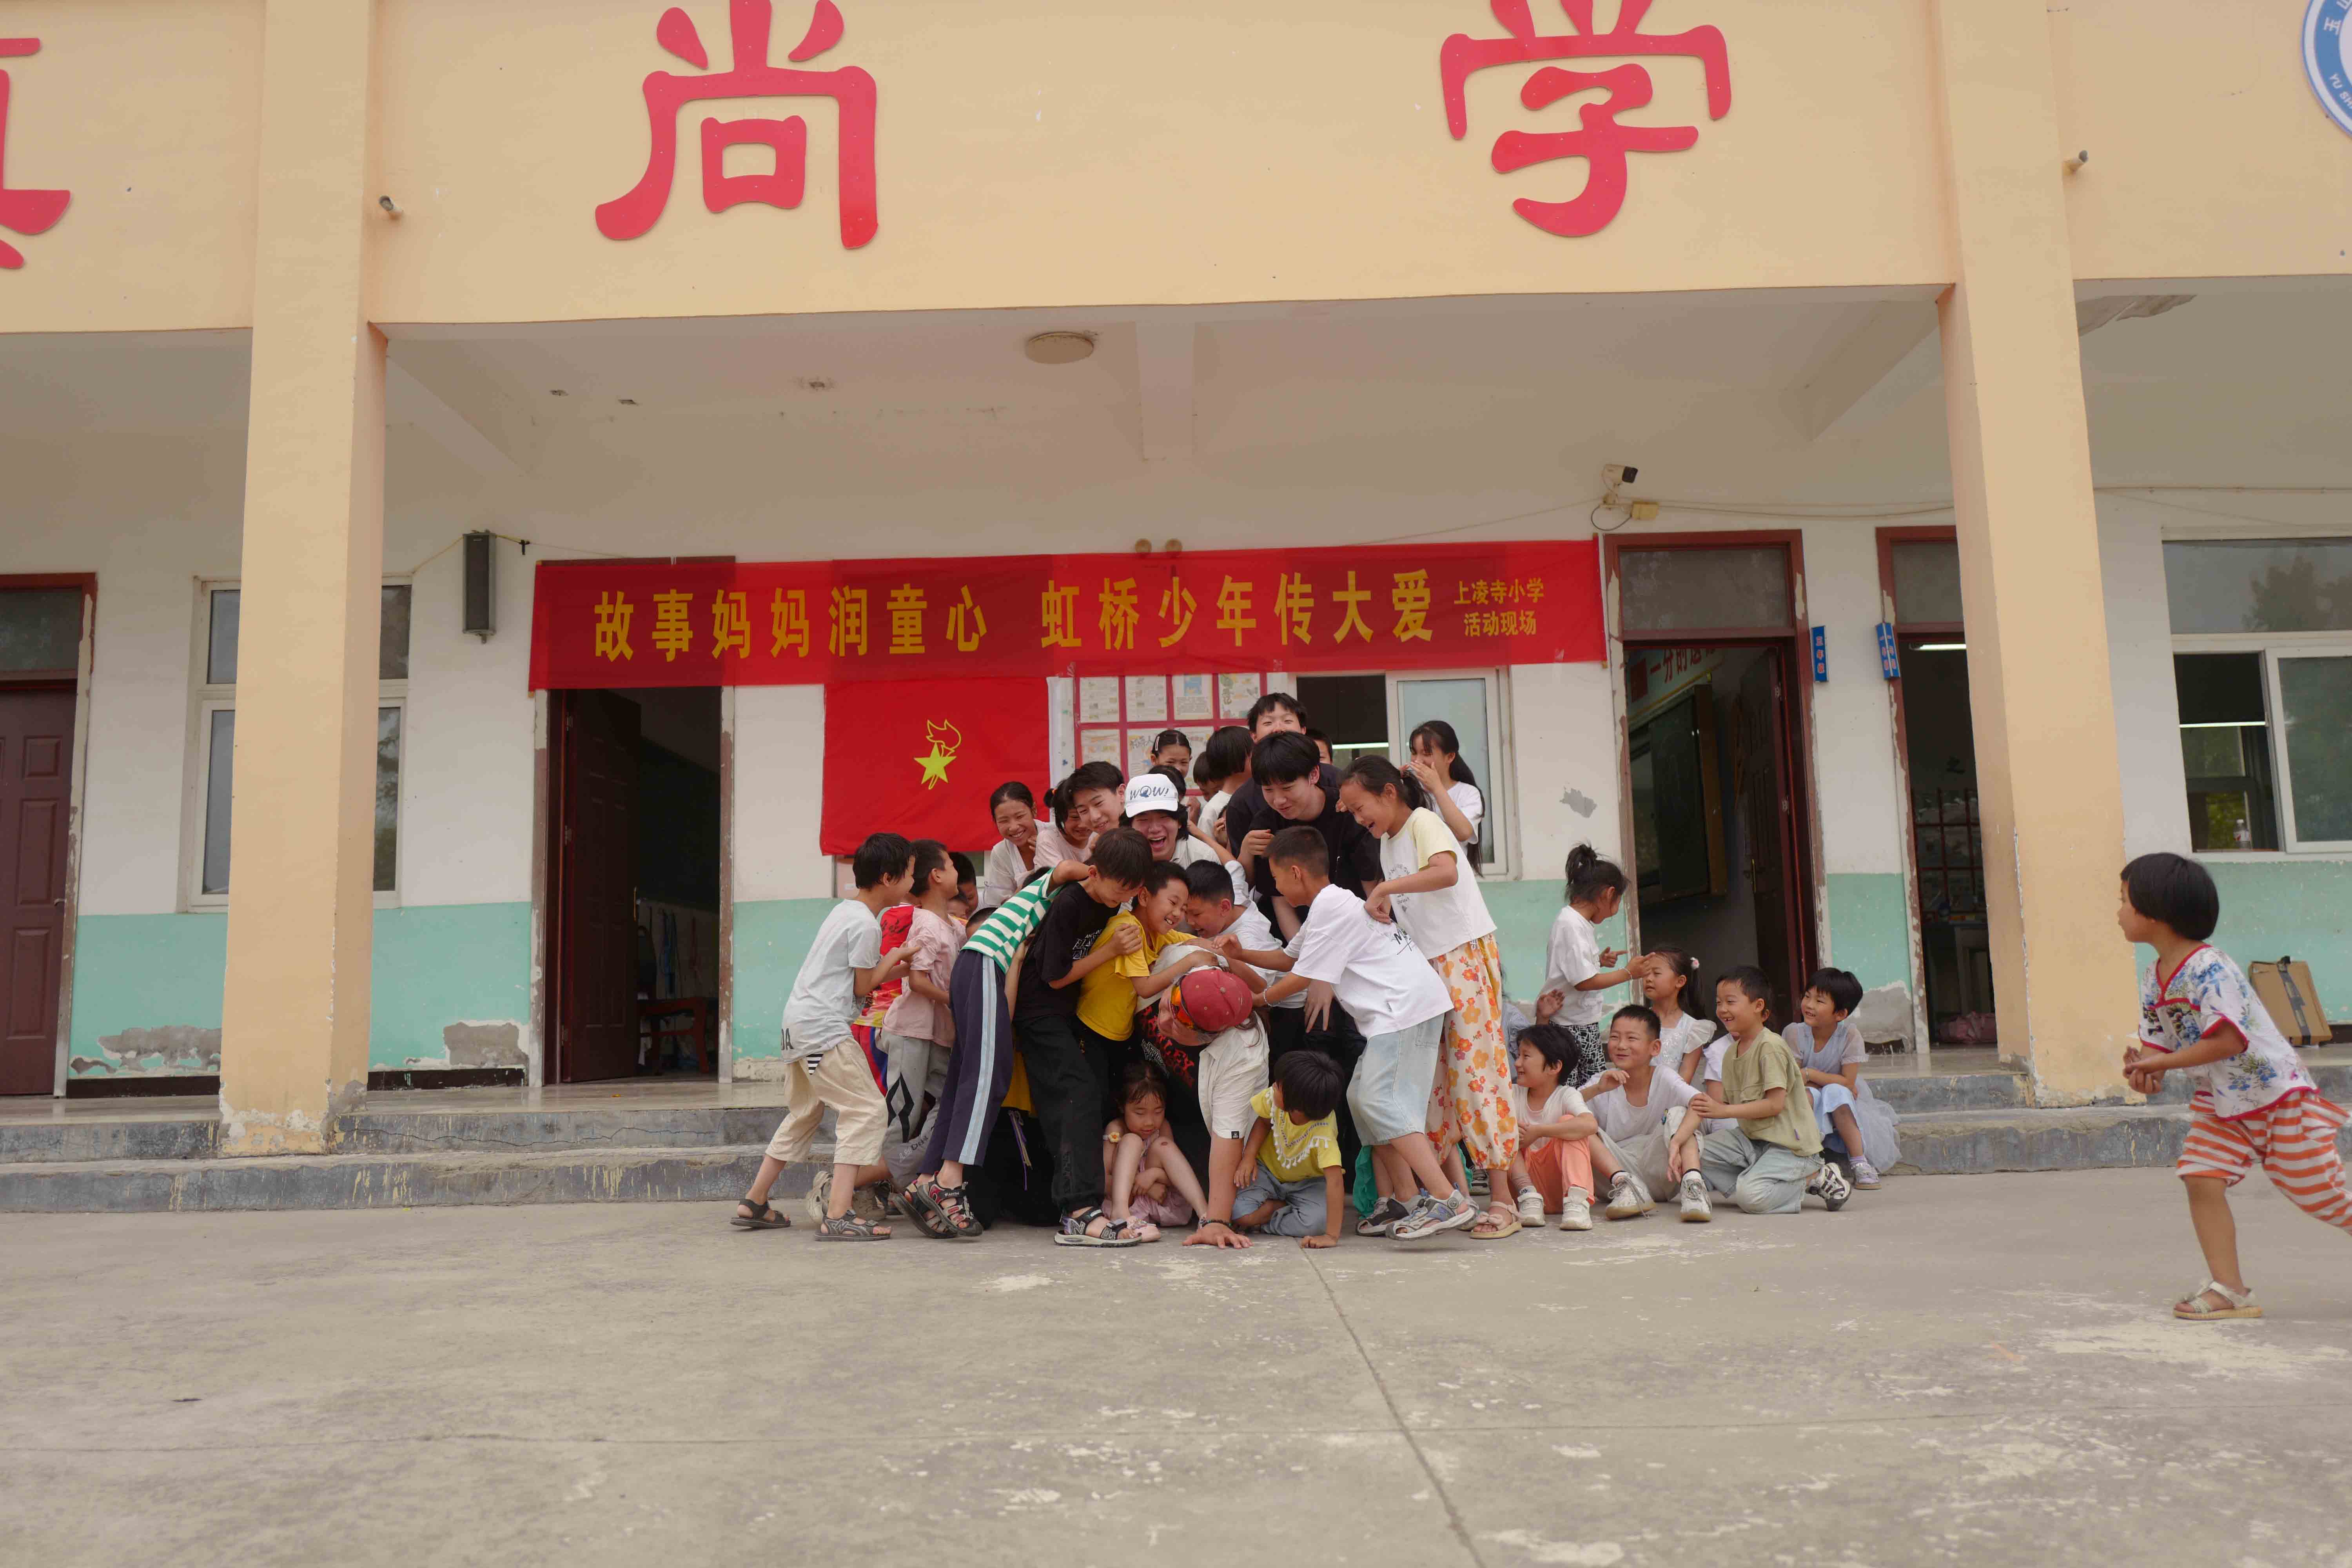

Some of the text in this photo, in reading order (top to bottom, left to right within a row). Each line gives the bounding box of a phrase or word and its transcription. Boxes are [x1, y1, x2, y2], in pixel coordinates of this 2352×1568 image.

[595, 0, 1731, 249] 尚 学
[593, 568, 1433, 662] 故事妈妈润童心 虹桥少年传大爱
[1454, 578, 1544, 604] 上凌寺小学
[1464, 610, 1537, 637] 活动现场
